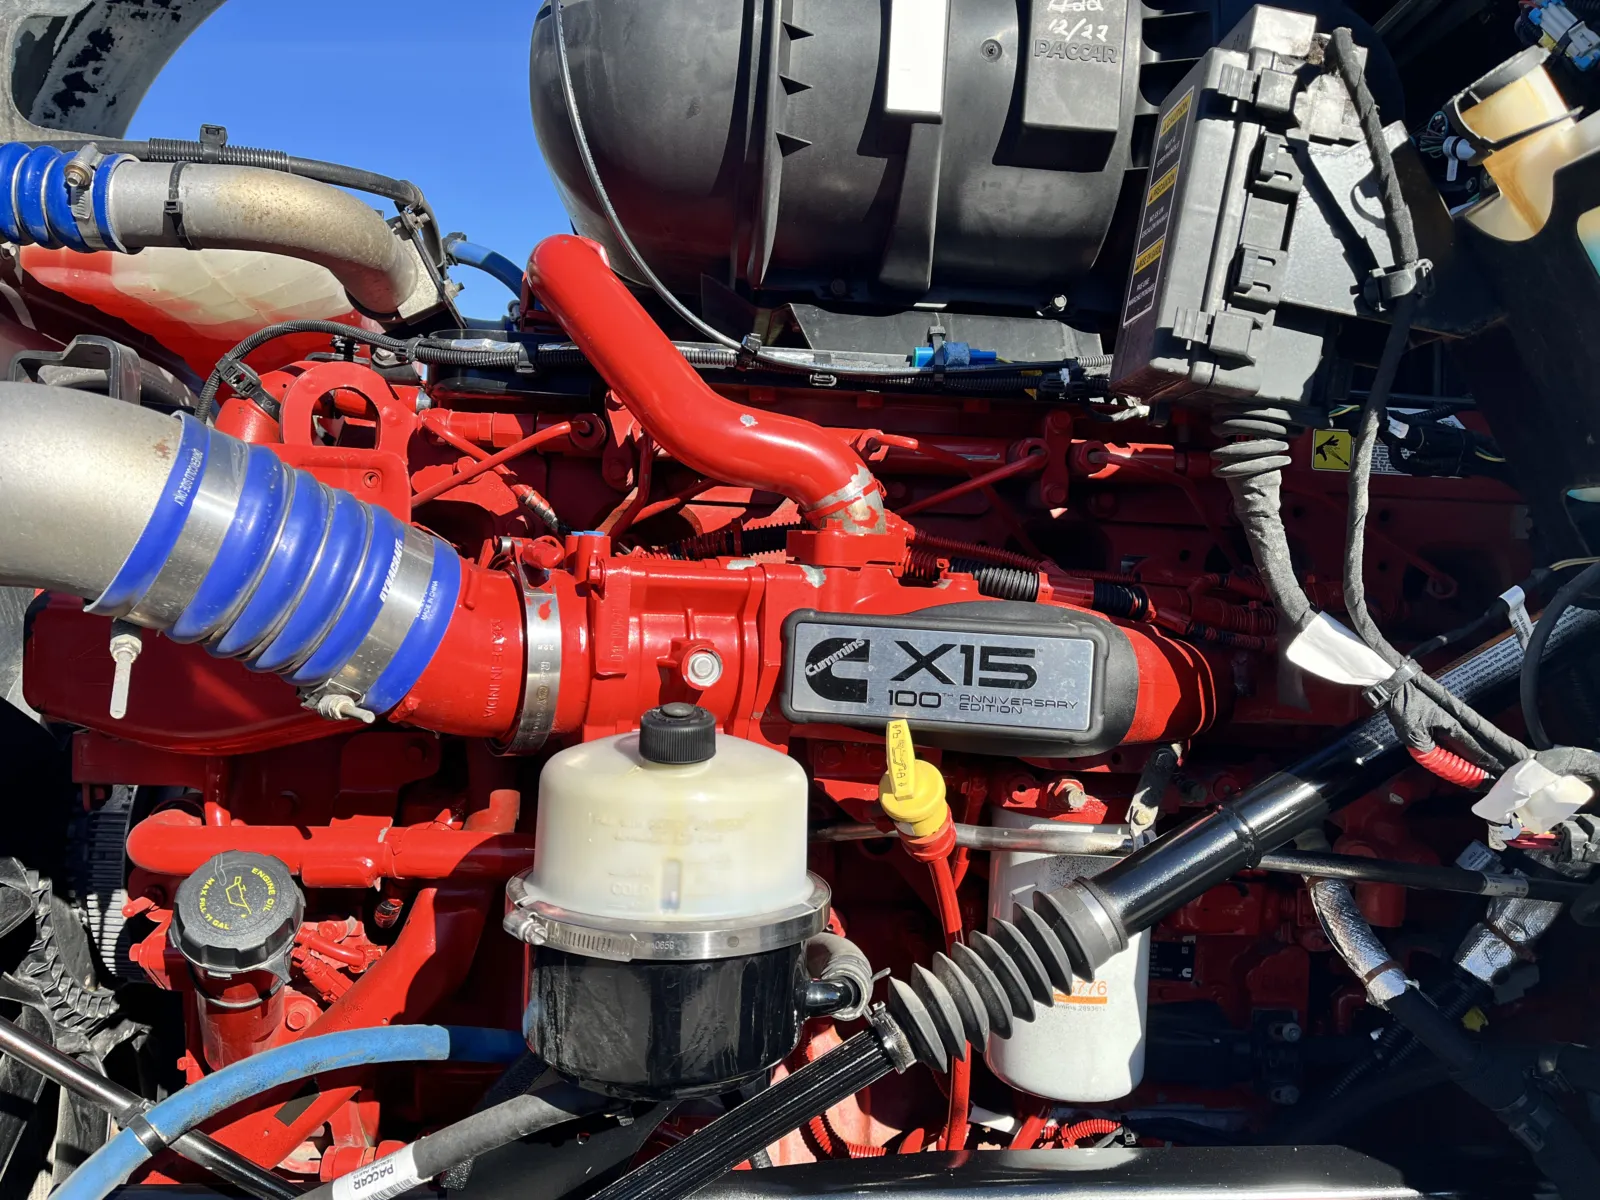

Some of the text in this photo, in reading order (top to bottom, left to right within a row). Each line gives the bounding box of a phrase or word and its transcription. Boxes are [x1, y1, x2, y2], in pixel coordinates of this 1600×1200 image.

[1034, 39, 1118, 64] PACCAR
[174, 489, 188, 506] ONLY
[379, 538, 403, 603] DYNACRAFT
[805, 637, 866, 677] Cummins
[889, 640, 1038, 690] X15
[490, 665, 503, 680] IN
[483, 684, 501, 718] INDIA
[959, 703, 1023, 714] EDITION
[960, 694, 1079, 710] ANNIVERSARY
[200, 877, 216, 896] MAX
[251, 867, 276, 912] ENGINE OIL
[199, 897, 207, 914] FILL
[212, 920, 230, 930] GAL
[350, 1163, 396, 1190] PACCAR
